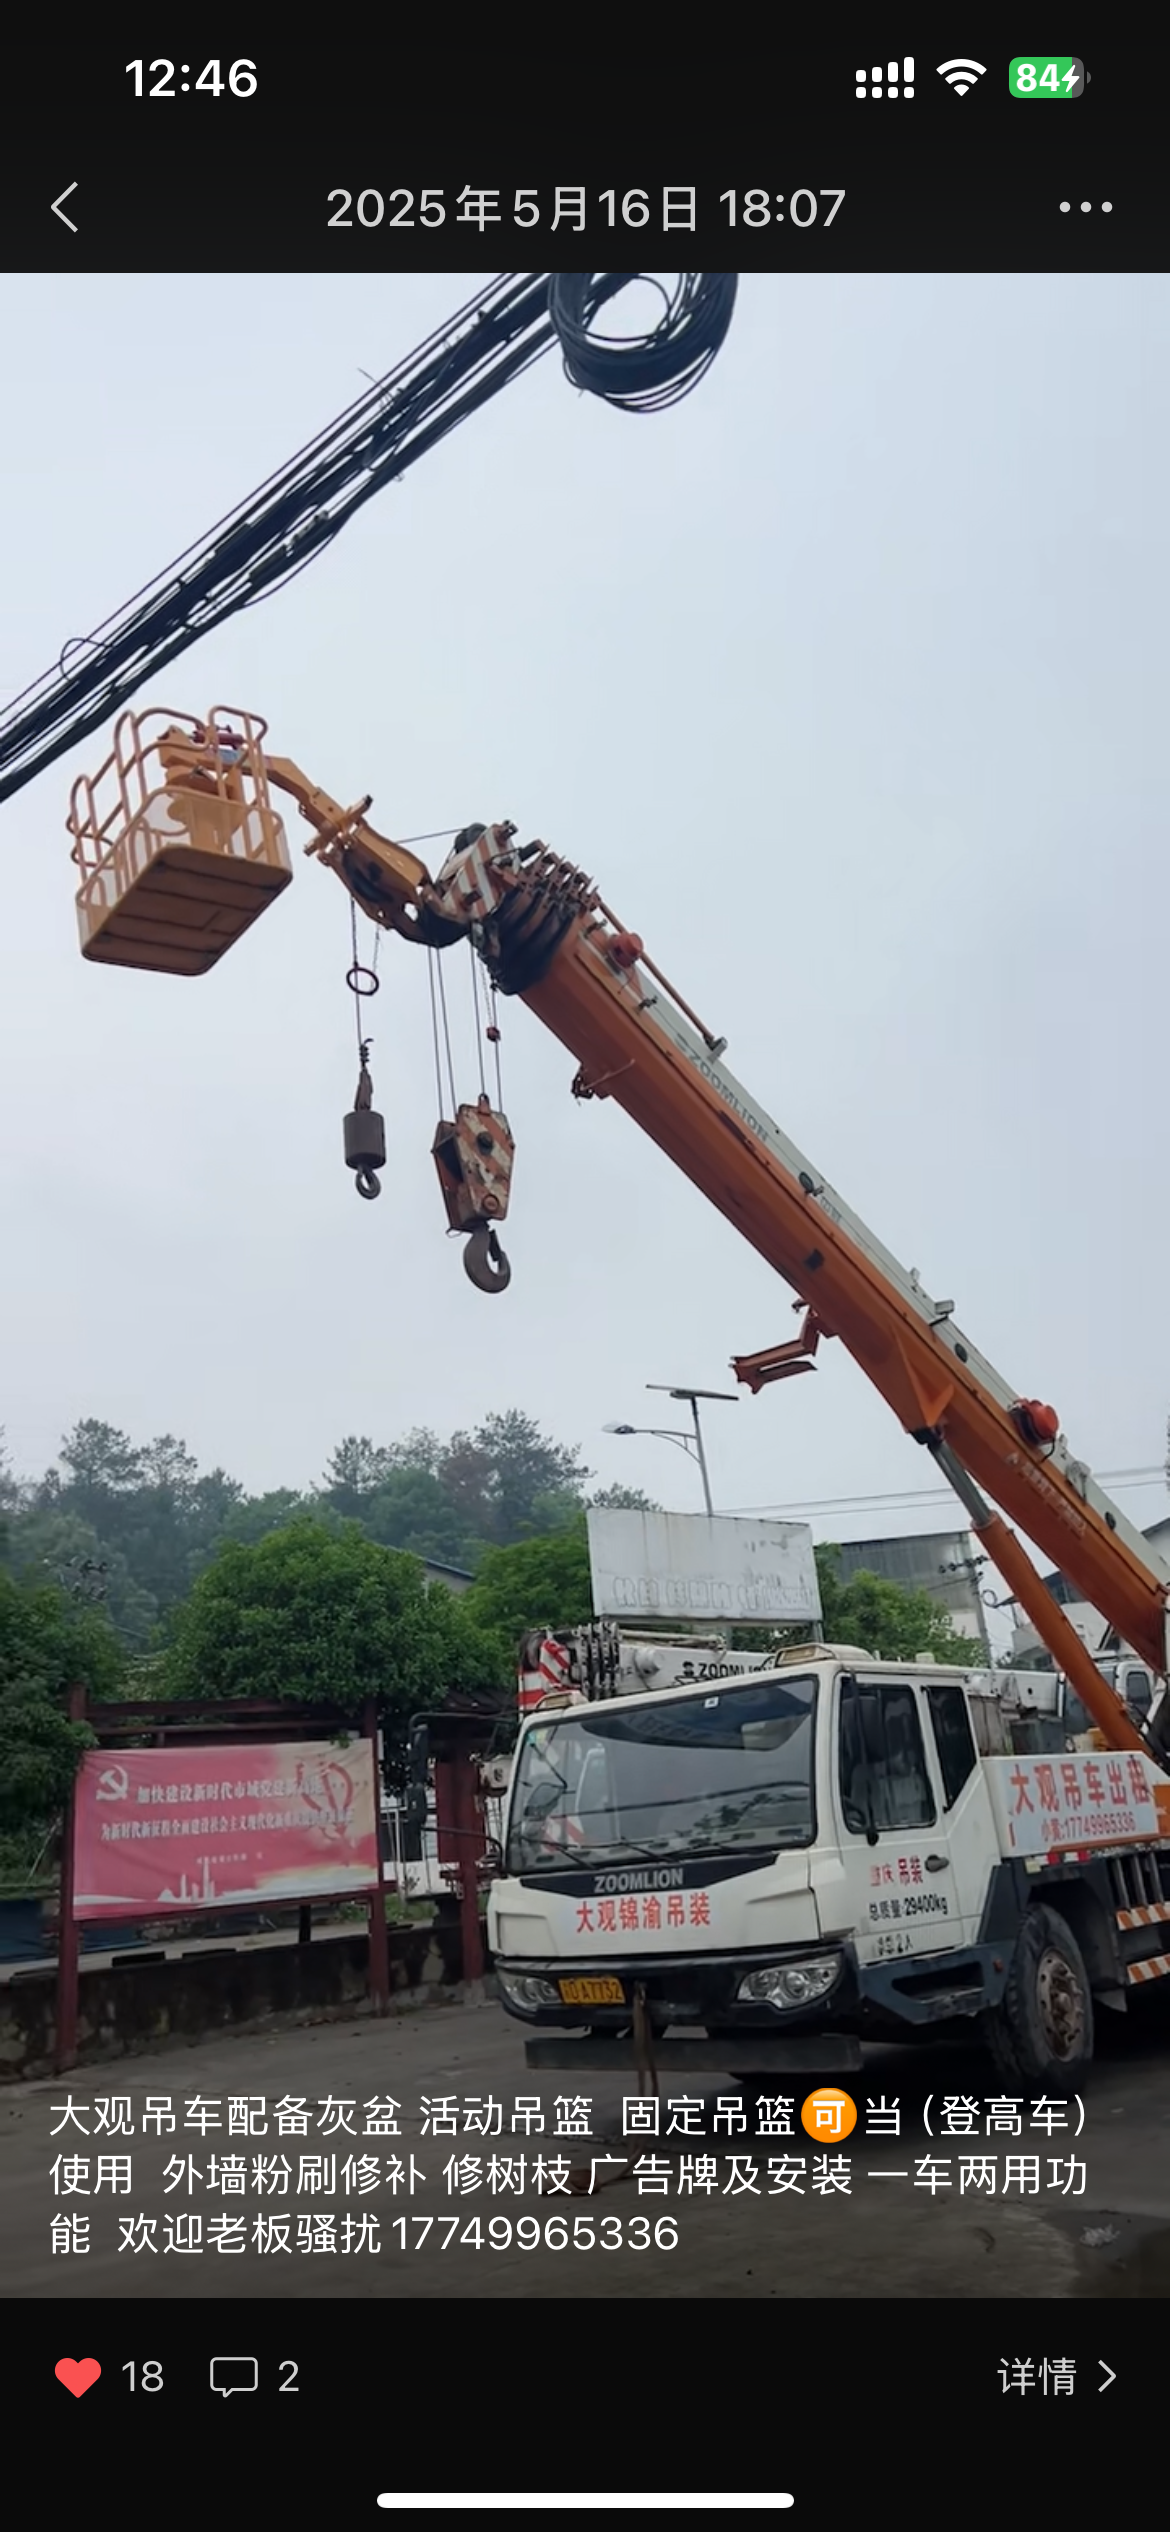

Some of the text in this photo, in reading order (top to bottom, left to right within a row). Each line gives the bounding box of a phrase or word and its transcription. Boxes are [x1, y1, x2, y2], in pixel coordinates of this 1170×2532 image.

[1010, 1758, 1150, 1815] 大观吊车出租
[593, 1868, 685, 1893] ZOOMLION
[575, 1892, 711, 1934] 大观锦渝吊装
